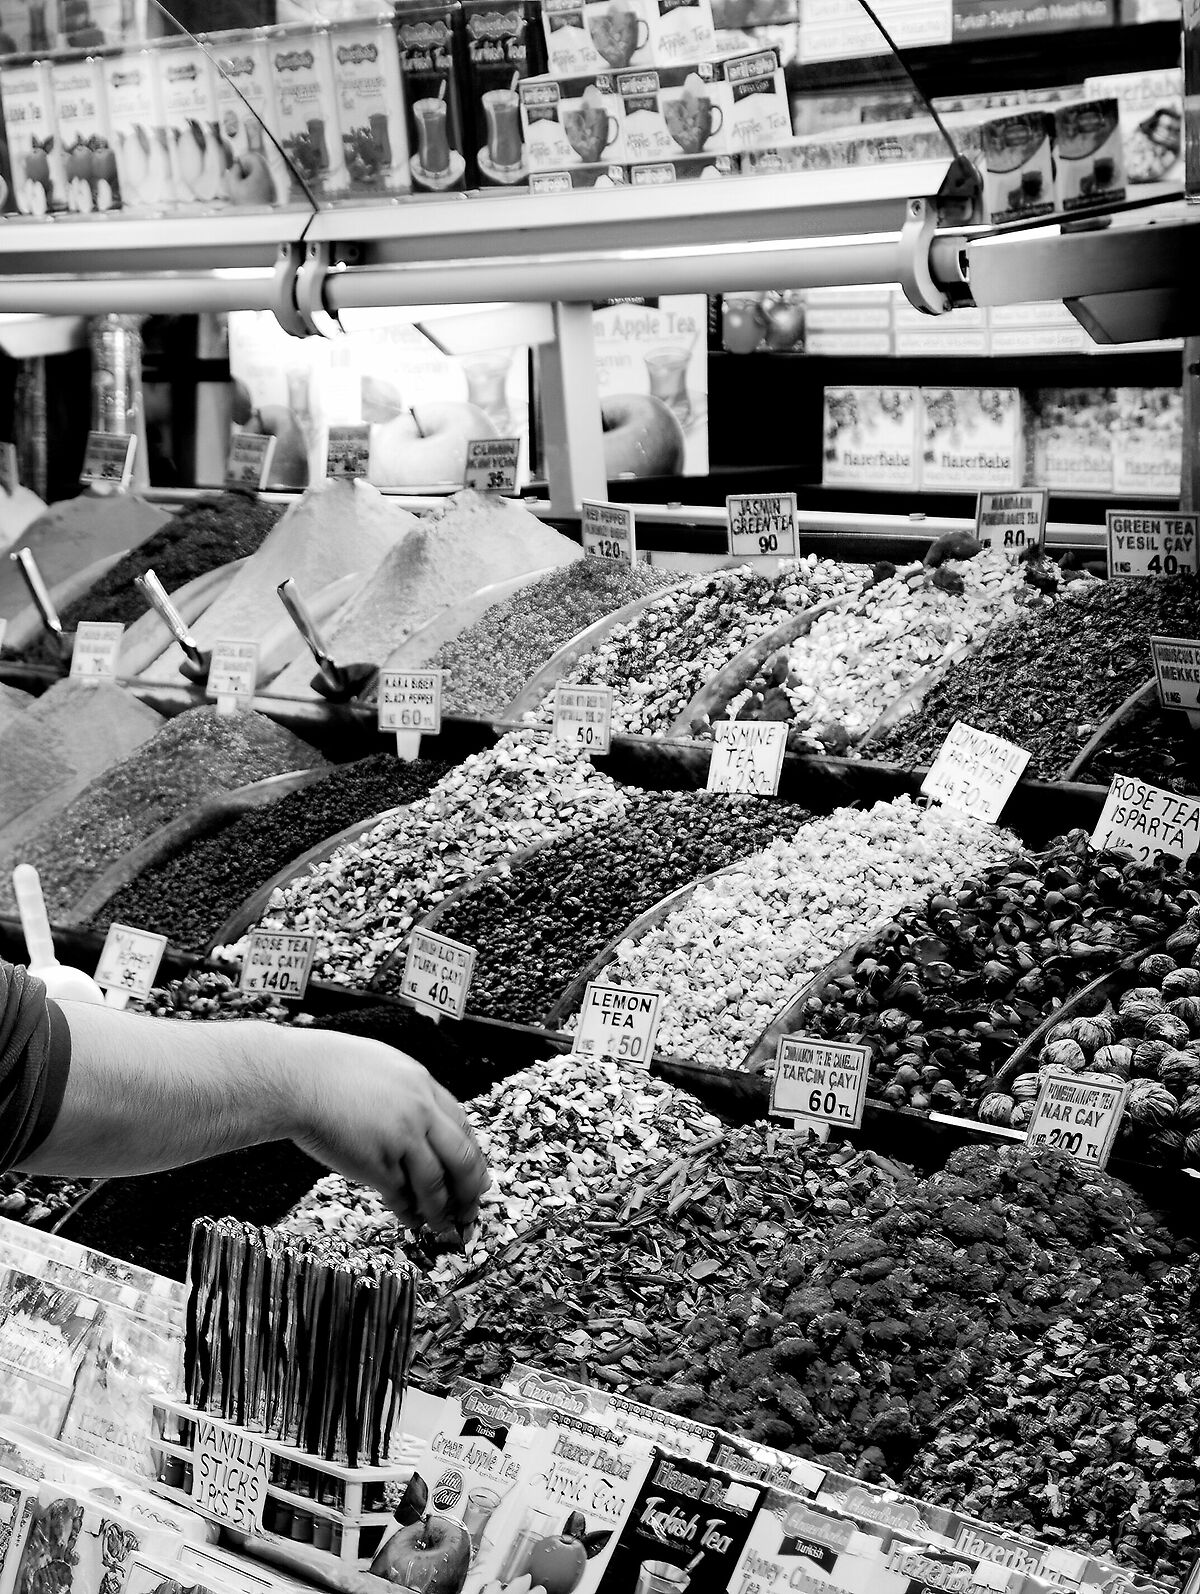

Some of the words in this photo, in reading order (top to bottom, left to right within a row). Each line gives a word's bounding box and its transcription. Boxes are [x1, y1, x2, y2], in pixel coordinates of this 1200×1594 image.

[658, 31, 689, 52] Apple
[693, 24, 711, 41] Tea
[732, 121, 765, 140] Apple
[768, 113, 787, 131] Tea
[612, 313, 662, 341] Apple
[667, 312, 697, 334] Tea
[732, 516, 771, 536] GREEN
[1113, 518, 1161, 535] GREEN
[1164, 520, 1194, 536] TEA
[598, 539, 621, 560] 120
[758, 534, 778, 554] 90
[1116, 535, 1159, 551] YESIL
[1147, 554, 1178, 576] 40
[401, 708, 422, 726] 60
[576, 726, 594, 745] 50
[725, 746, 756, 770] TEA
[1110, 776, 1158, 811] ROSE
[1161, 796, 1200, 832] TEA
[1110, 804, 1184, 850] ISPARTA
[261, 970, 291, 991] 140
[428, 982, 449, 1005] 40
[591, 991, 653, 1014] LEMON
[601, 1010, 634, 1029] TEA
[808, 1089, 837, 1115] 60
[838, 1104, 852, 1118] TL
[1041, 1101, 1073, 1123] NAR
[1048, 1128, 1084, 1156] 200
[431, 1431, 465, 1456] Green
[465, 1442, 497, 1474] Apple
[496, 1453, 521, 1481] Tea
[551, 1432, 595, 1467] Hazer
[591, 1447, 632, 1482] Baba
[529, 1460, 589, 1506] Apple
[591, 1477, 628, 1517] Tea
[651, 1458, 708, 1502] Hazer
[639, 1496, 700, 1544] Turkish
[699, 1518, 735, 1556] Tea
[794, 1539, 826, 1561] Turkish
